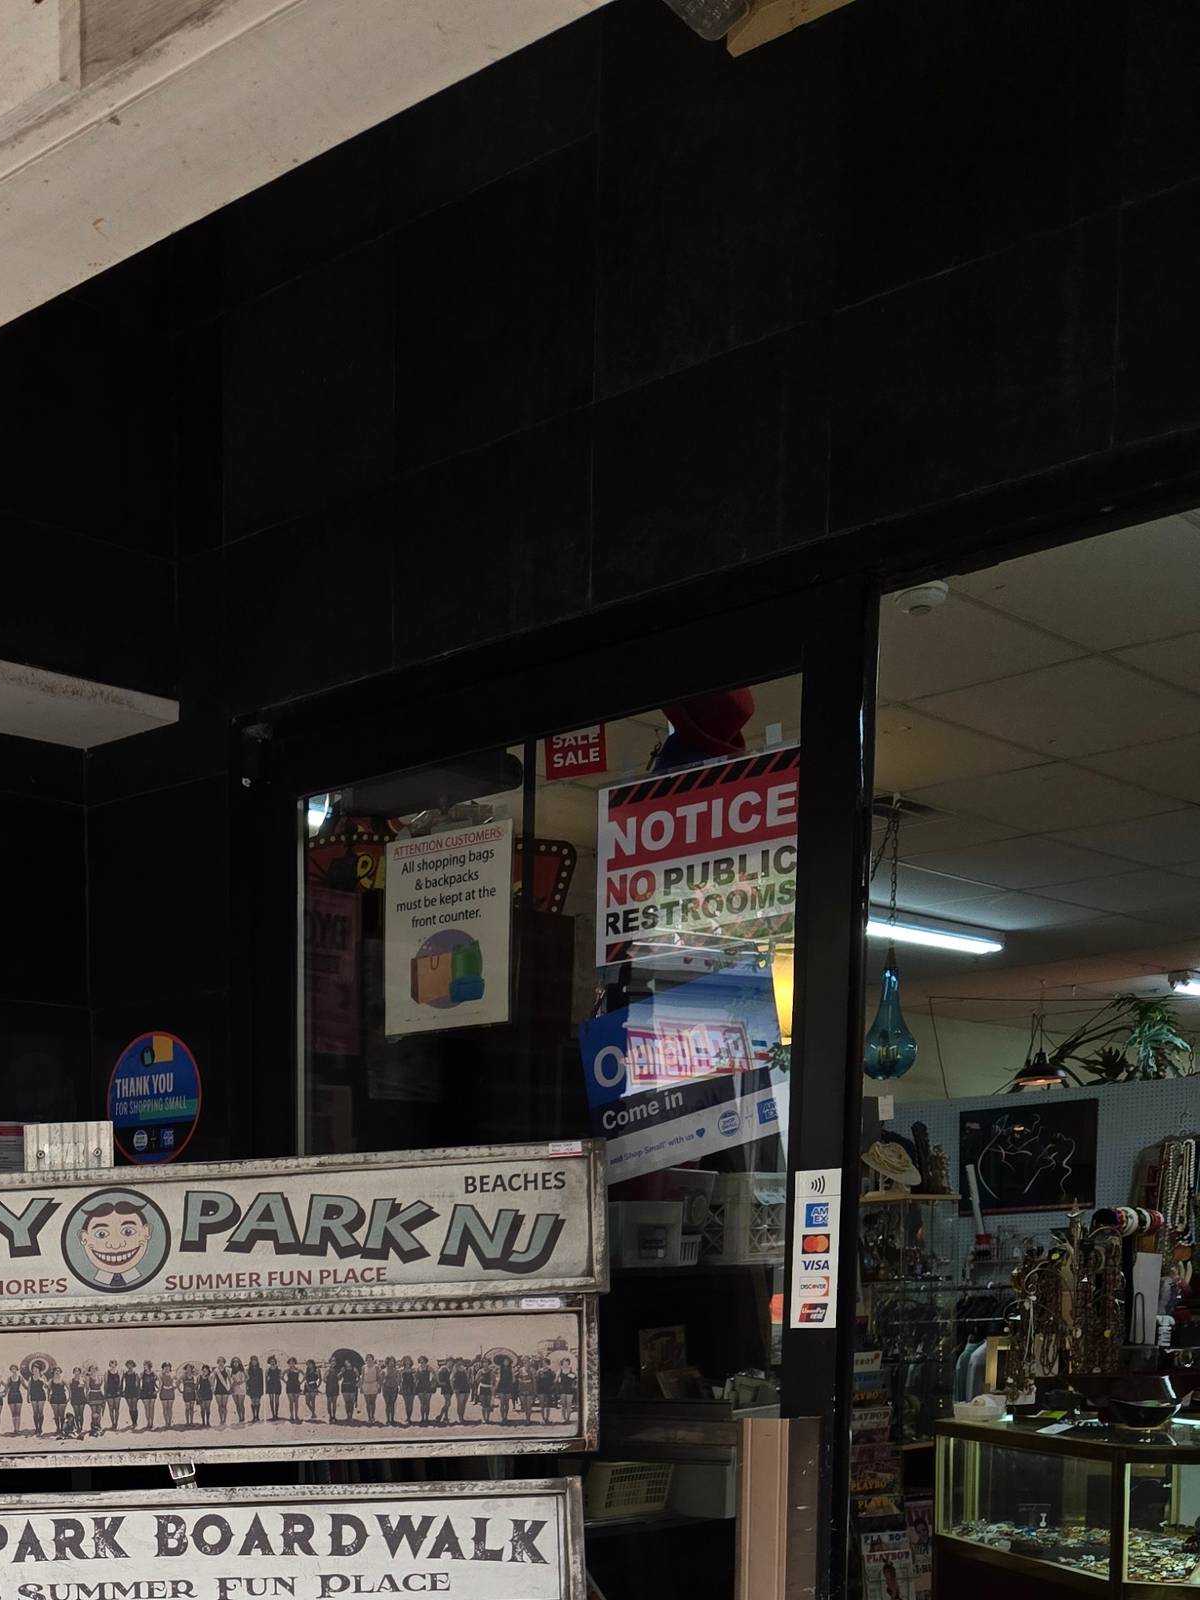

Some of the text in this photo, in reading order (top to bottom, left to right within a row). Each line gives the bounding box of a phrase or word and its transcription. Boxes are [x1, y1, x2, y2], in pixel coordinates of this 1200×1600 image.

[552, 731, 600, 749] SALE
[553, 747, 600, 767] SALE
[607, 781, 797, 859] NOTICE
[393, 839, 444, 857] ATTENTION
[402, 848, 494, 875] All shopping bags
[415, 870, 479, 891] & backpacks
[606, 845, 797, 908] NO PUBLIC
[396, 886, 496, 912] must be kept at the
[606, 879, 796, 937] RESTROOMS
[411, 908, 481, 928] front counter.
[115, 1072, 174, 1099] THANK YOU
[115, 1096, 187, 1116] FOR SHOPPING SMALL
[602, 1089, 683, 1130] Come in
[624, 1148, 643, 1161] Shop
[667, 1135, 685, 1147] with
[685, 1133, 694, 1142] us
[464, 1171, 566, 1193] BEACHES
[179, 1189, 440, 1264] PARK
[438, 1202, 566, 1273] NJ
[802, 1260, 830, 1270] VISA
[165, 1270, 262, 1291] SUMMER
[267, 1269, 313, 1287] FUN
[318, 1266, 387, 1284] PLACE
[154, 1511, 550, 1566] BOARDWALK
[865, 1551, 910, 1563] PLAYBOY
[216, 1575, 298, 1600] FUN
[316, 1572, 451, 1599] PLACE
